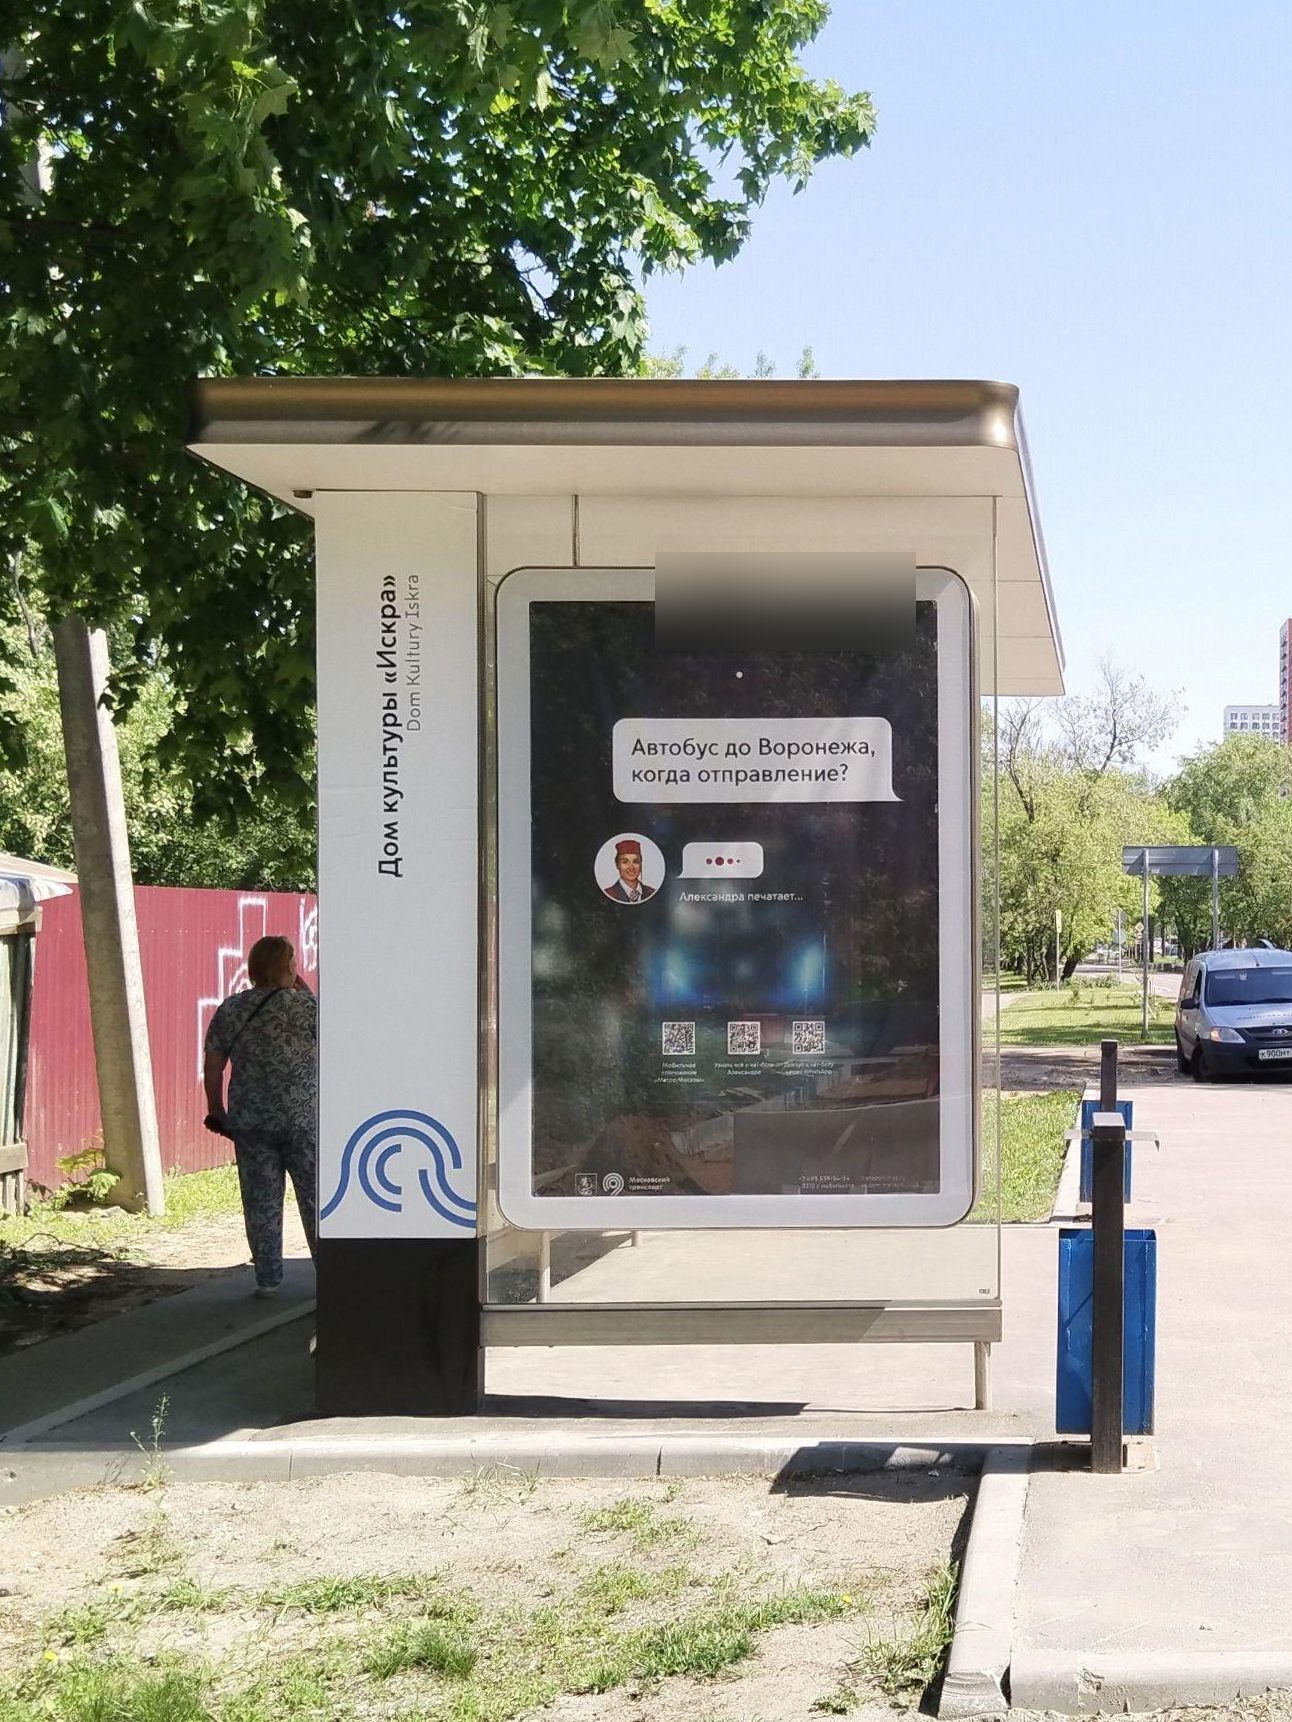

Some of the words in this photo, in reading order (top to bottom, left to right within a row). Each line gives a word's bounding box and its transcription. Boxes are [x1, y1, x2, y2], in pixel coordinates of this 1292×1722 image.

[404, 574, 420, 618] Iskra
[376, 575, 402, 683] «Искра»
[405, 623, 423, 685] Kultury
[406, 692, 421, 731] Dom
[382, 692, 404, 812] культуры
[631, 737, 719, 760] Автобус
[724, 741, 751, 758] до
[759, 737, 876, 759] Воронежа,
[631, 767, 691, 784] когда
[697, 763, 849, 786] отправление?
[378, 821, 403, 877] Дом
[679, 891, 745, 904] Александра
